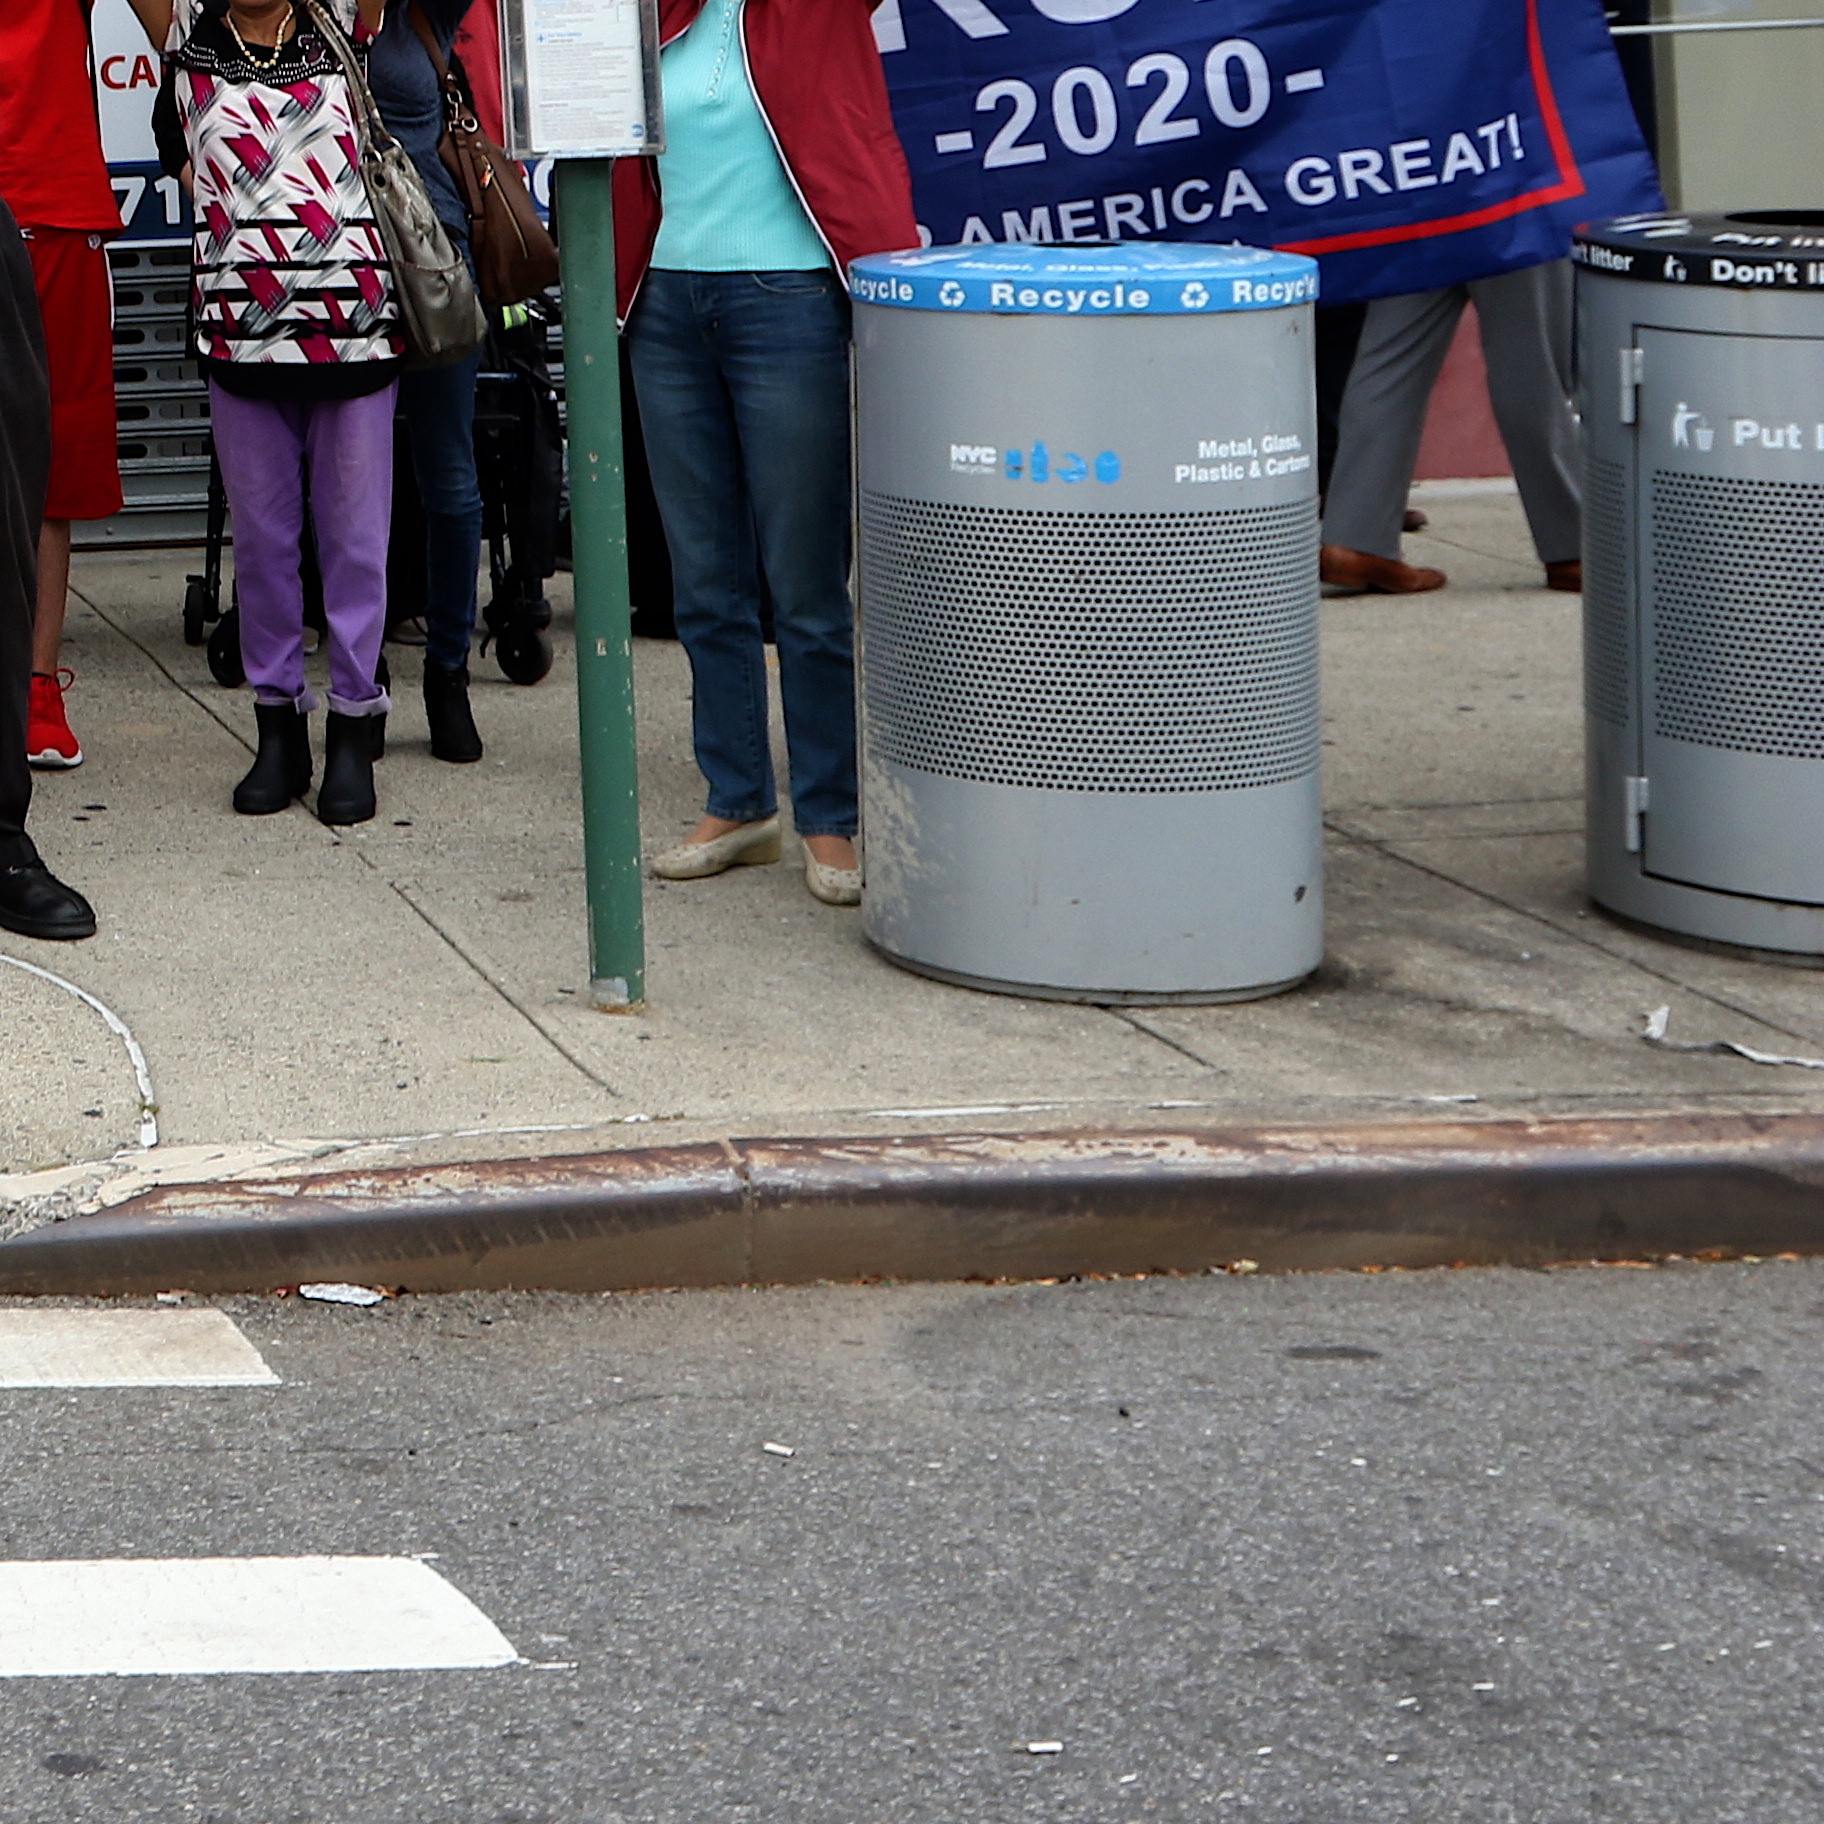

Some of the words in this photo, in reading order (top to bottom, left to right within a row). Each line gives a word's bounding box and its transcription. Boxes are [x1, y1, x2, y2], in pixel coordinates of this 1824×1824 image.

[934, 38, 1327, 170] -2020-
[1284, 112, 1525, 208] GREAT!
[1590, 244, 1635, 273] litter
[1710, 257, 1799, 284] Don't
[989, 281, 1151, 312] Recycle
[1198, 436, 1258, 460] Metal,
[1733, 418, 1802, 450] Put
[950, 443, 998, 465] NYC
[1174, 458, 1245, 484] Plastic
[1248, 458, 1261, 478] &
